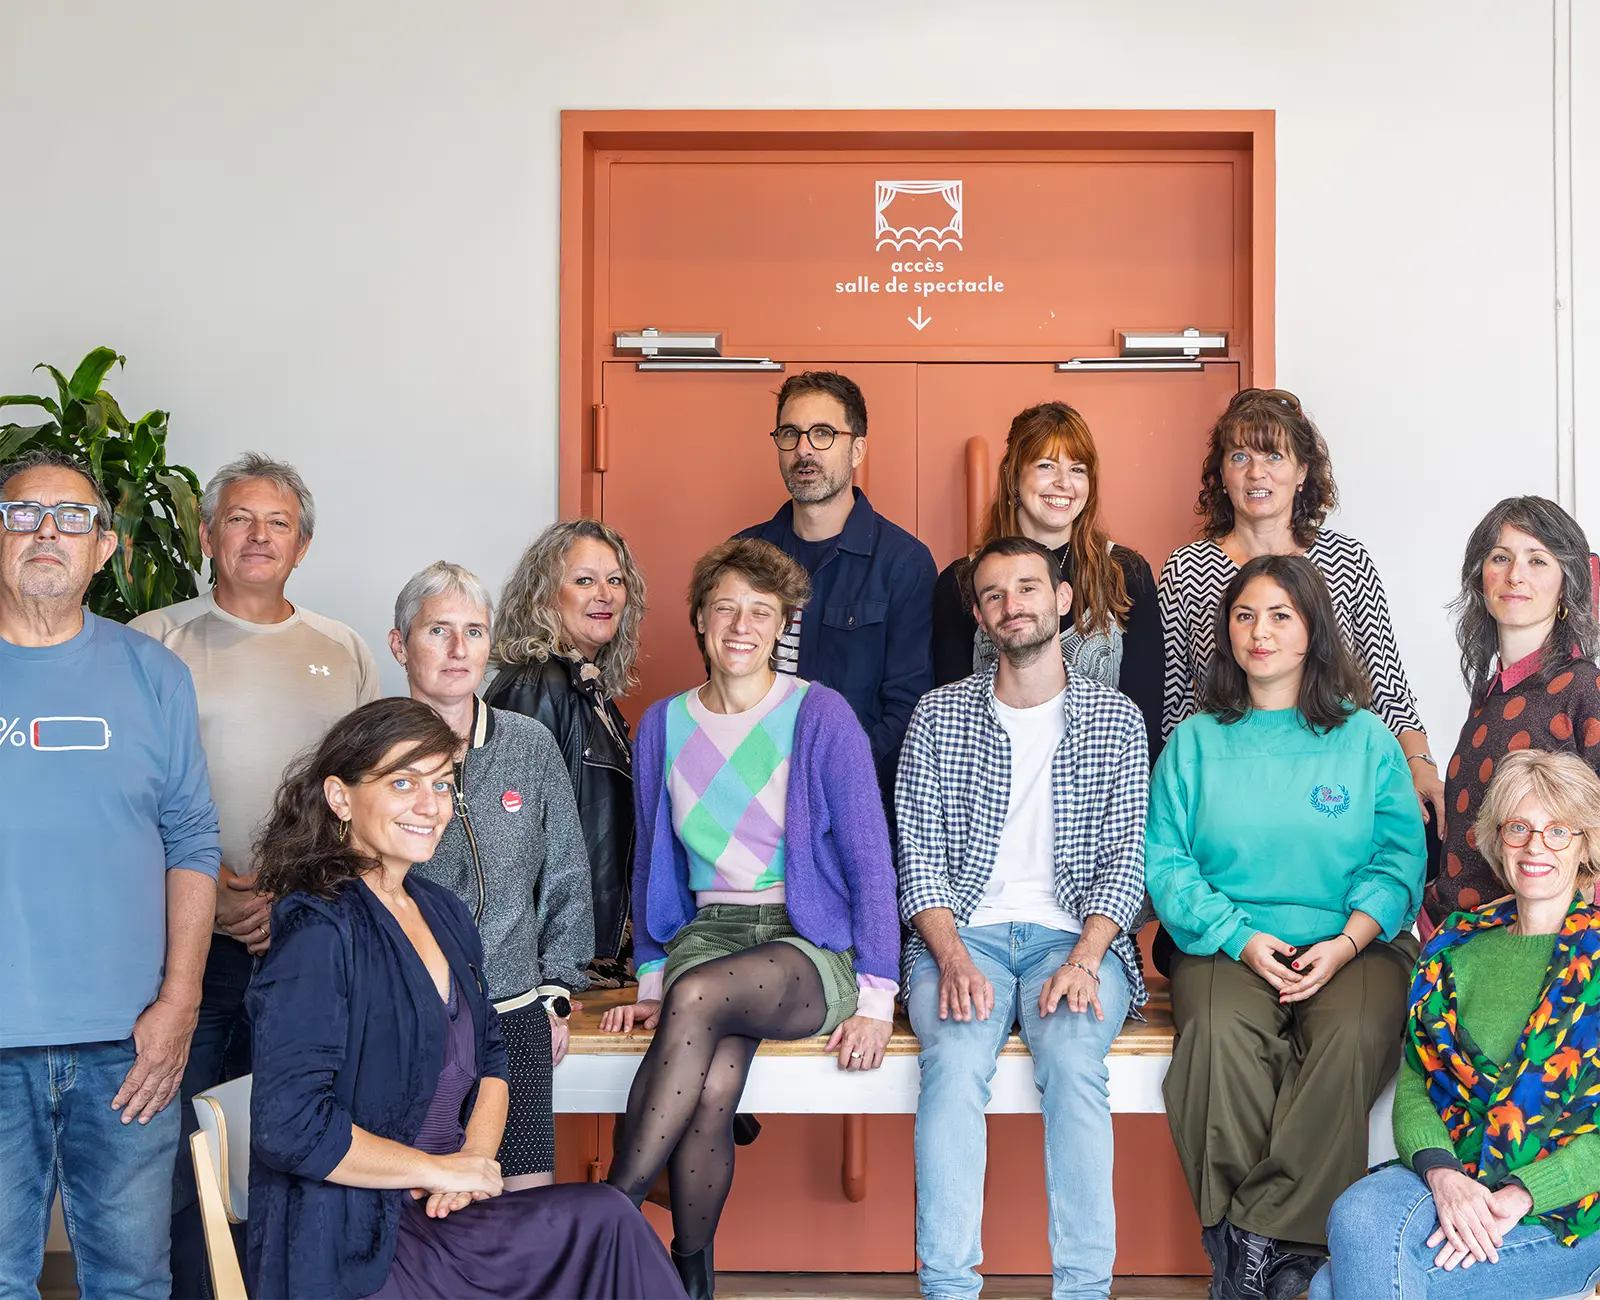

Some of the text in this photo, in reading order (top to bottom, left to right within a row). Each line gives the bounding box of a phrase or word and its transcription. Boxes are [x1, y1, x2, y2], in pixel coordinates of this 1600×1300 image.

[891, 257, 944, 273] accès
[835, 275, 1005, 297] salle de spectacle
